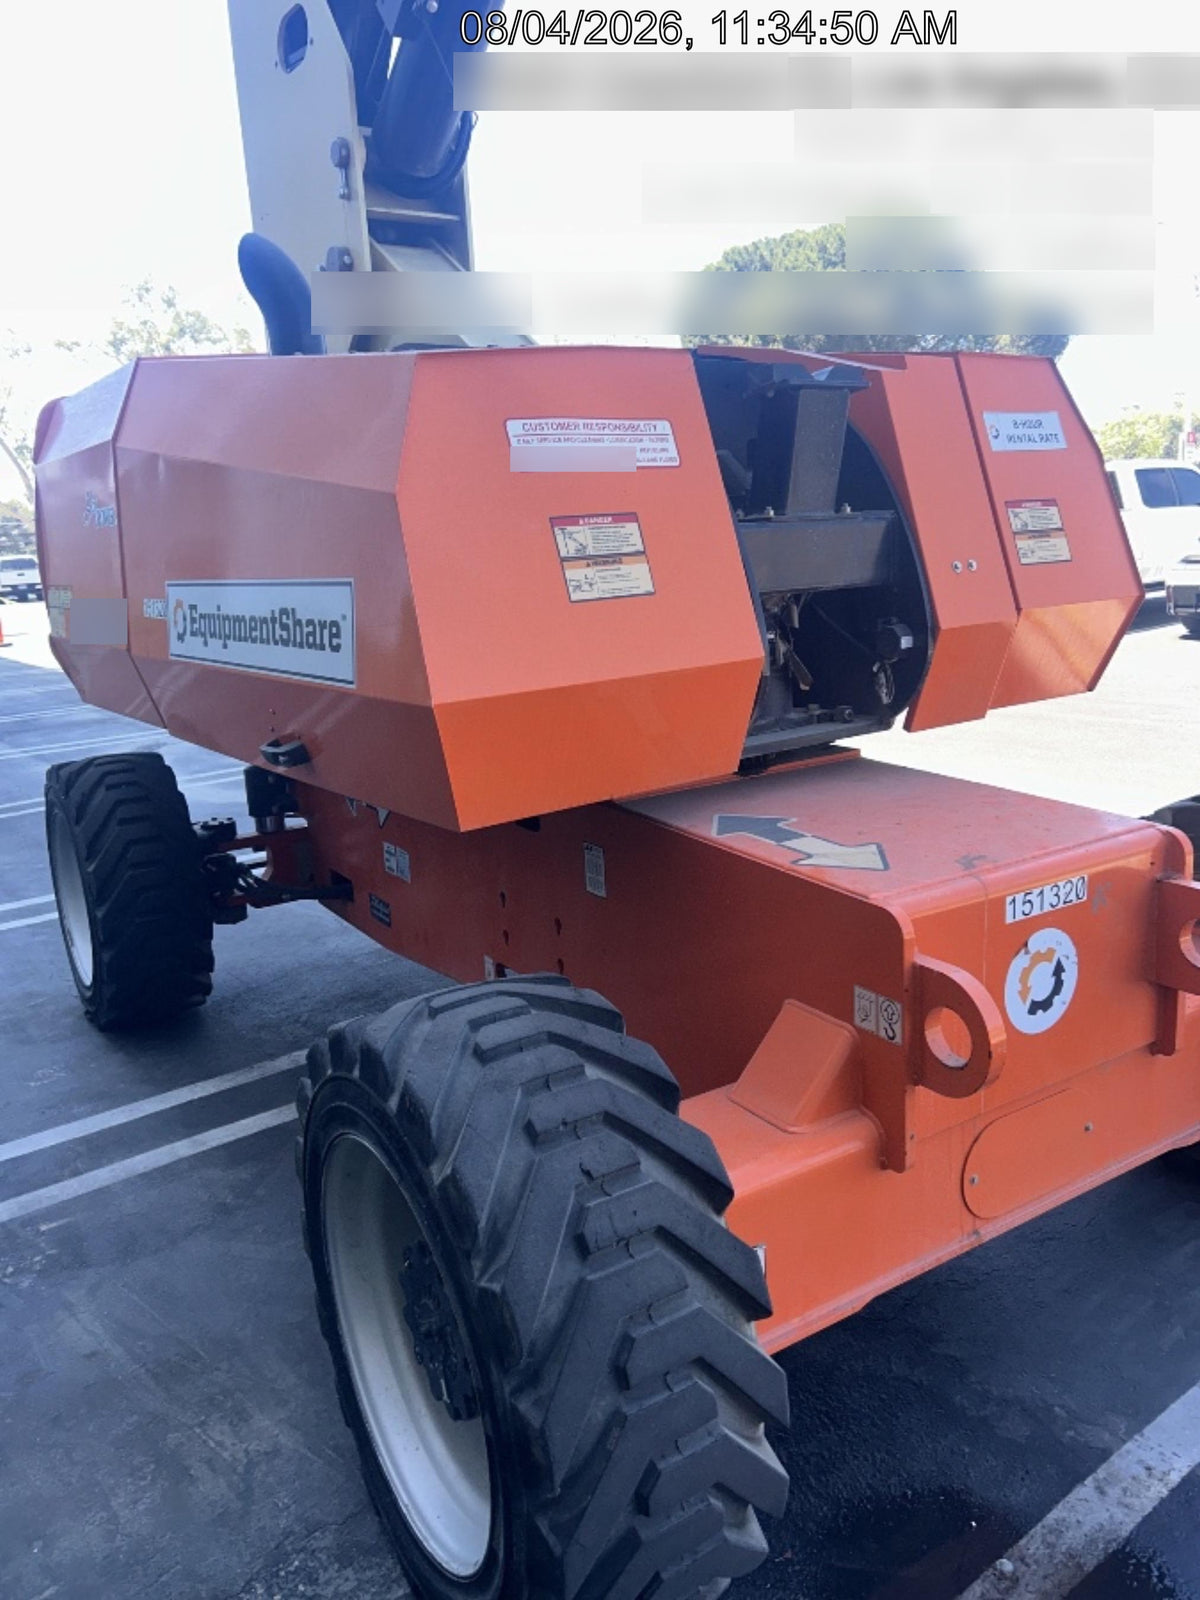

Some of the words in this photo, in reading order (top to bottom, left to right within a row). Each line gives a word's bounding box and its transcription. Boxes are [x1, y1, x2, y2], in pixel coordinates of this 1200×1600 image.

[522, 421, 580, 433] CUSTOMER
[188, 604, 342, 653] EquipmentShare
[1008, 876, 1086, 920] 151320
